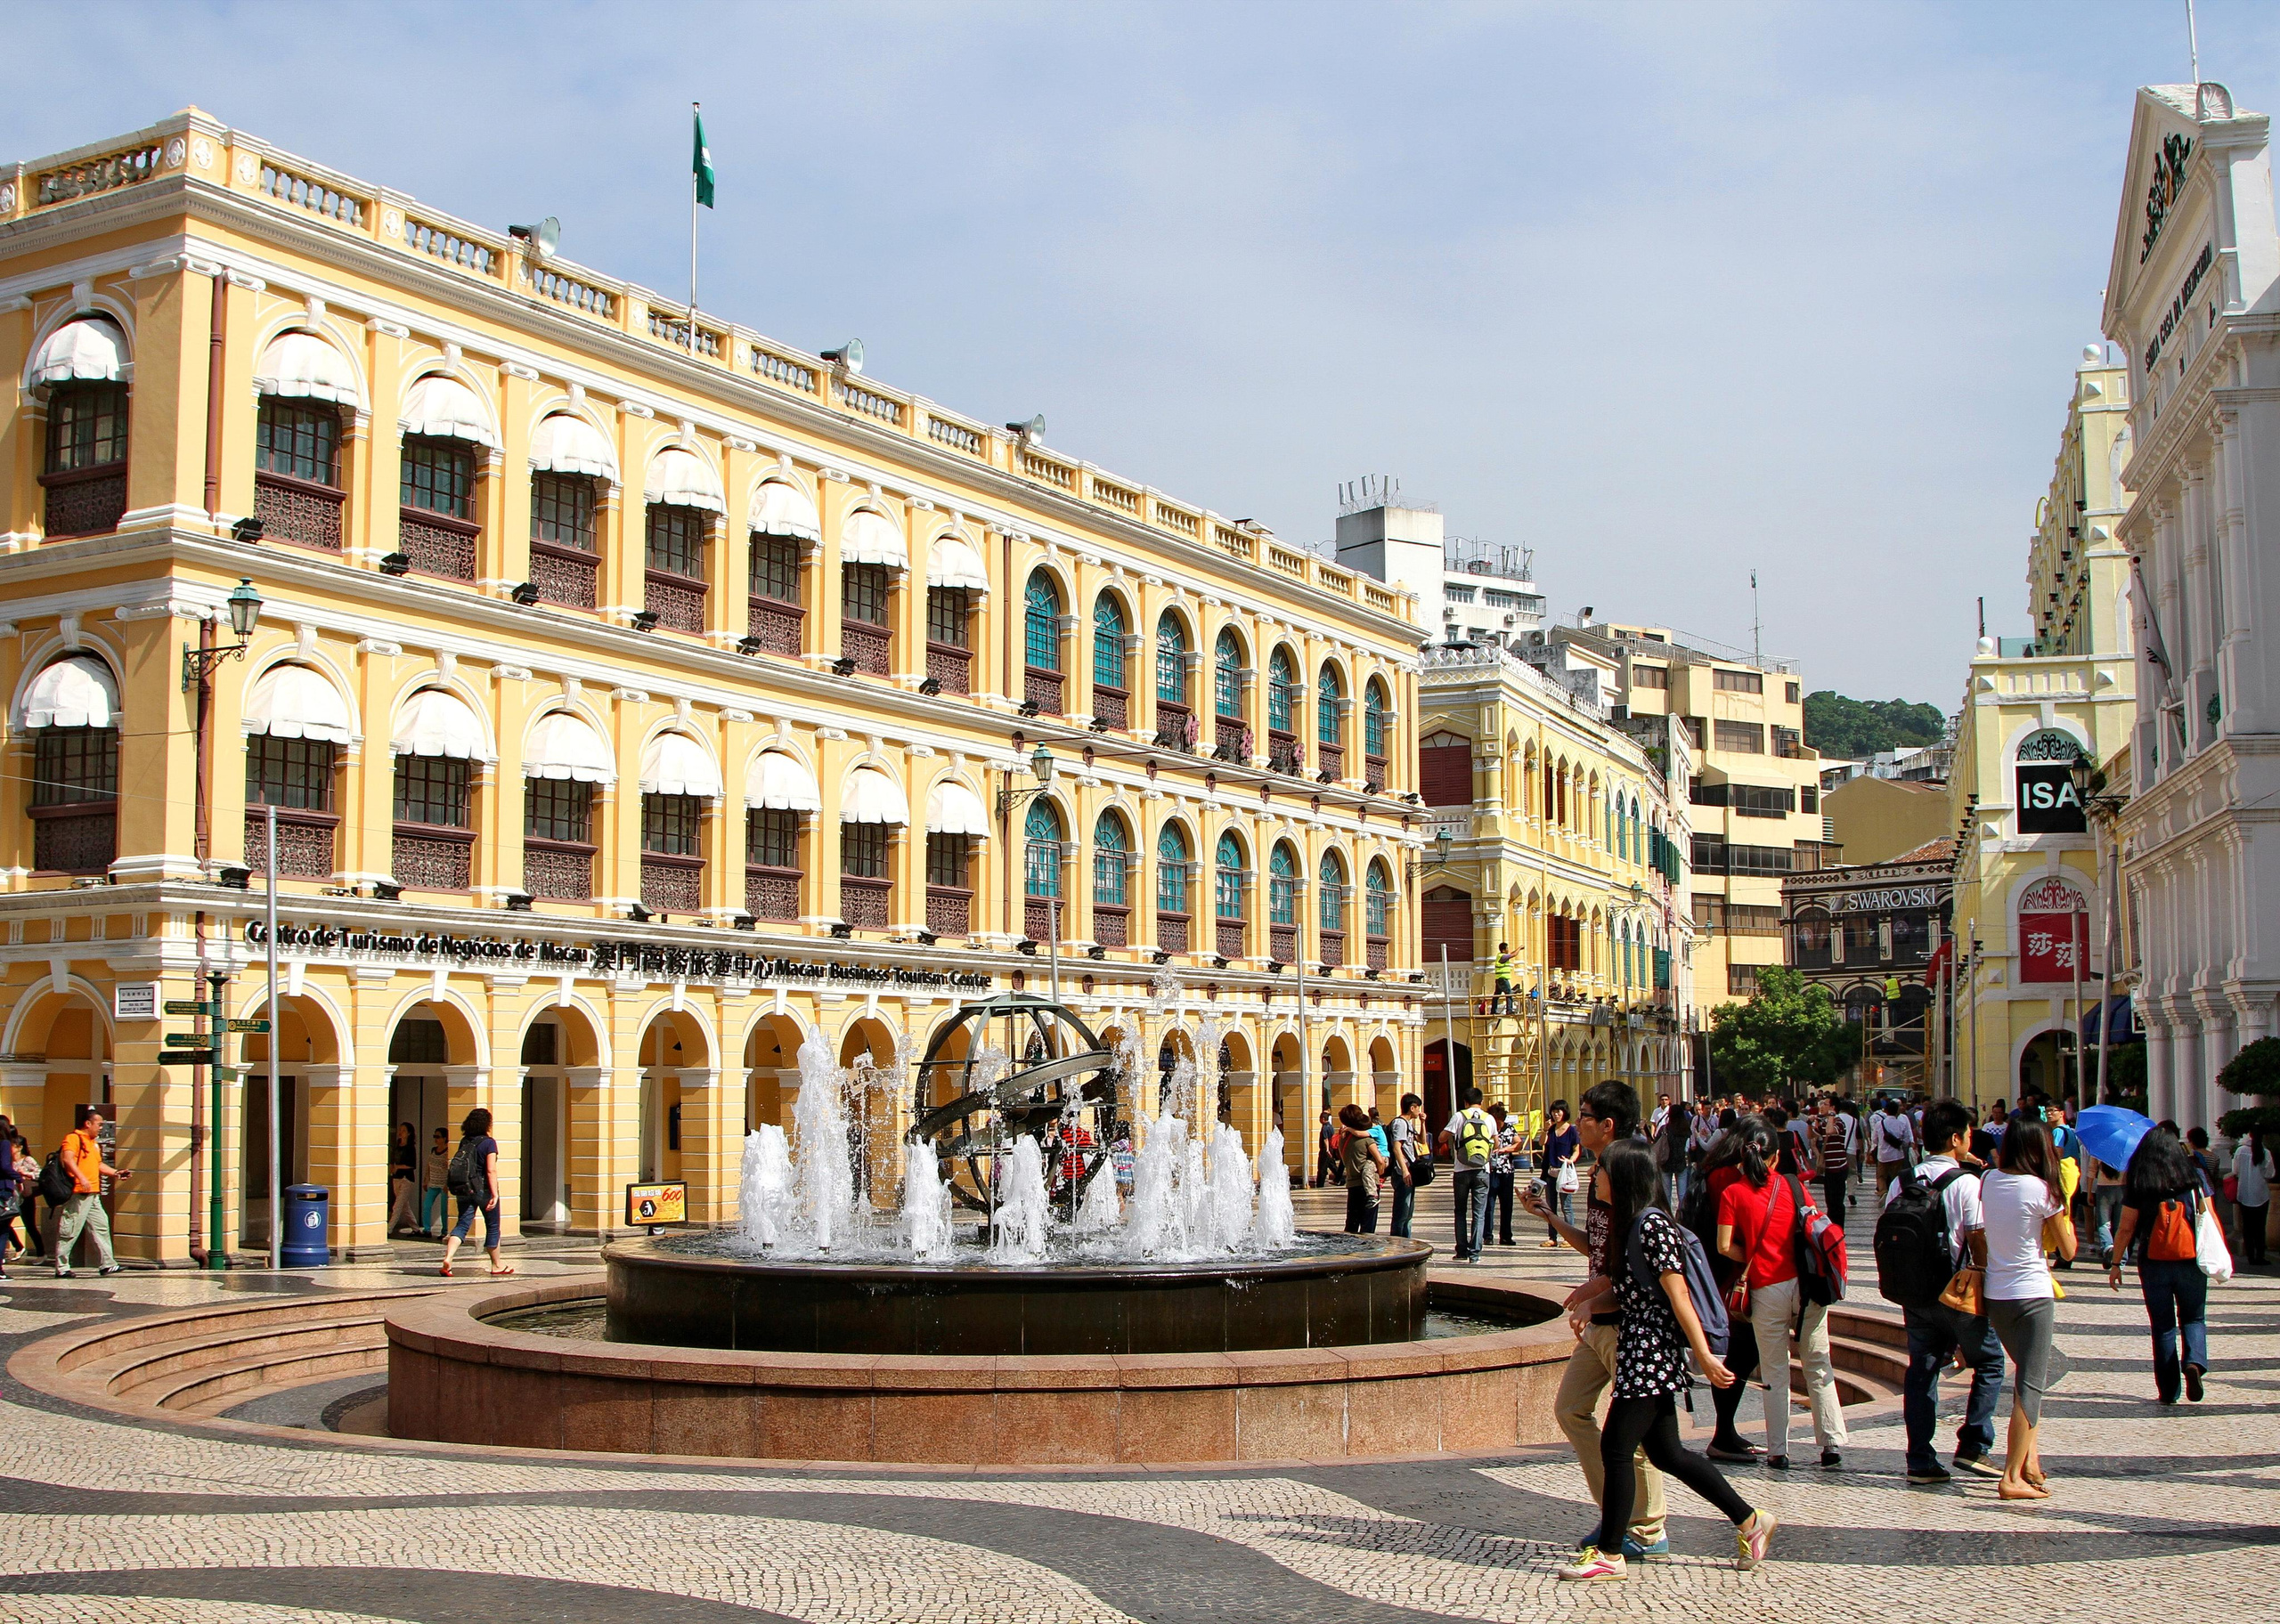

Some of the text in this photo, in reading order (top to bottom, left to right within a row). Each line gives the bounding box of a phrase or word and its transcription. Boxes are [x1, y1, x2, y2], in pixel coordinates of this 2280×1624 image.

[2160, 309, 2174, 346] CASA
[2173, 296, 2182, 325] DA
[2023, 782, 2081, 809] ISA
[1849, 888, 1935, 910] SWAROVSKI
[312, 925, 336, 946] de
[338, 927, 414, 952] Turismo
[417, 933, 438, 954] de
[441, 935, 511, 961] Negócios
[514, 939, 534, 960] de
[540, 942, 587, 962] Macau
[2028, 932, 2082, 968] 莎莎
[592, 942, 771, 979] 澳門商務旅遊中心
[776, 959, 991, 987] Macau Business Tourism Centre
[662, 1188, 682, 1202] 600
